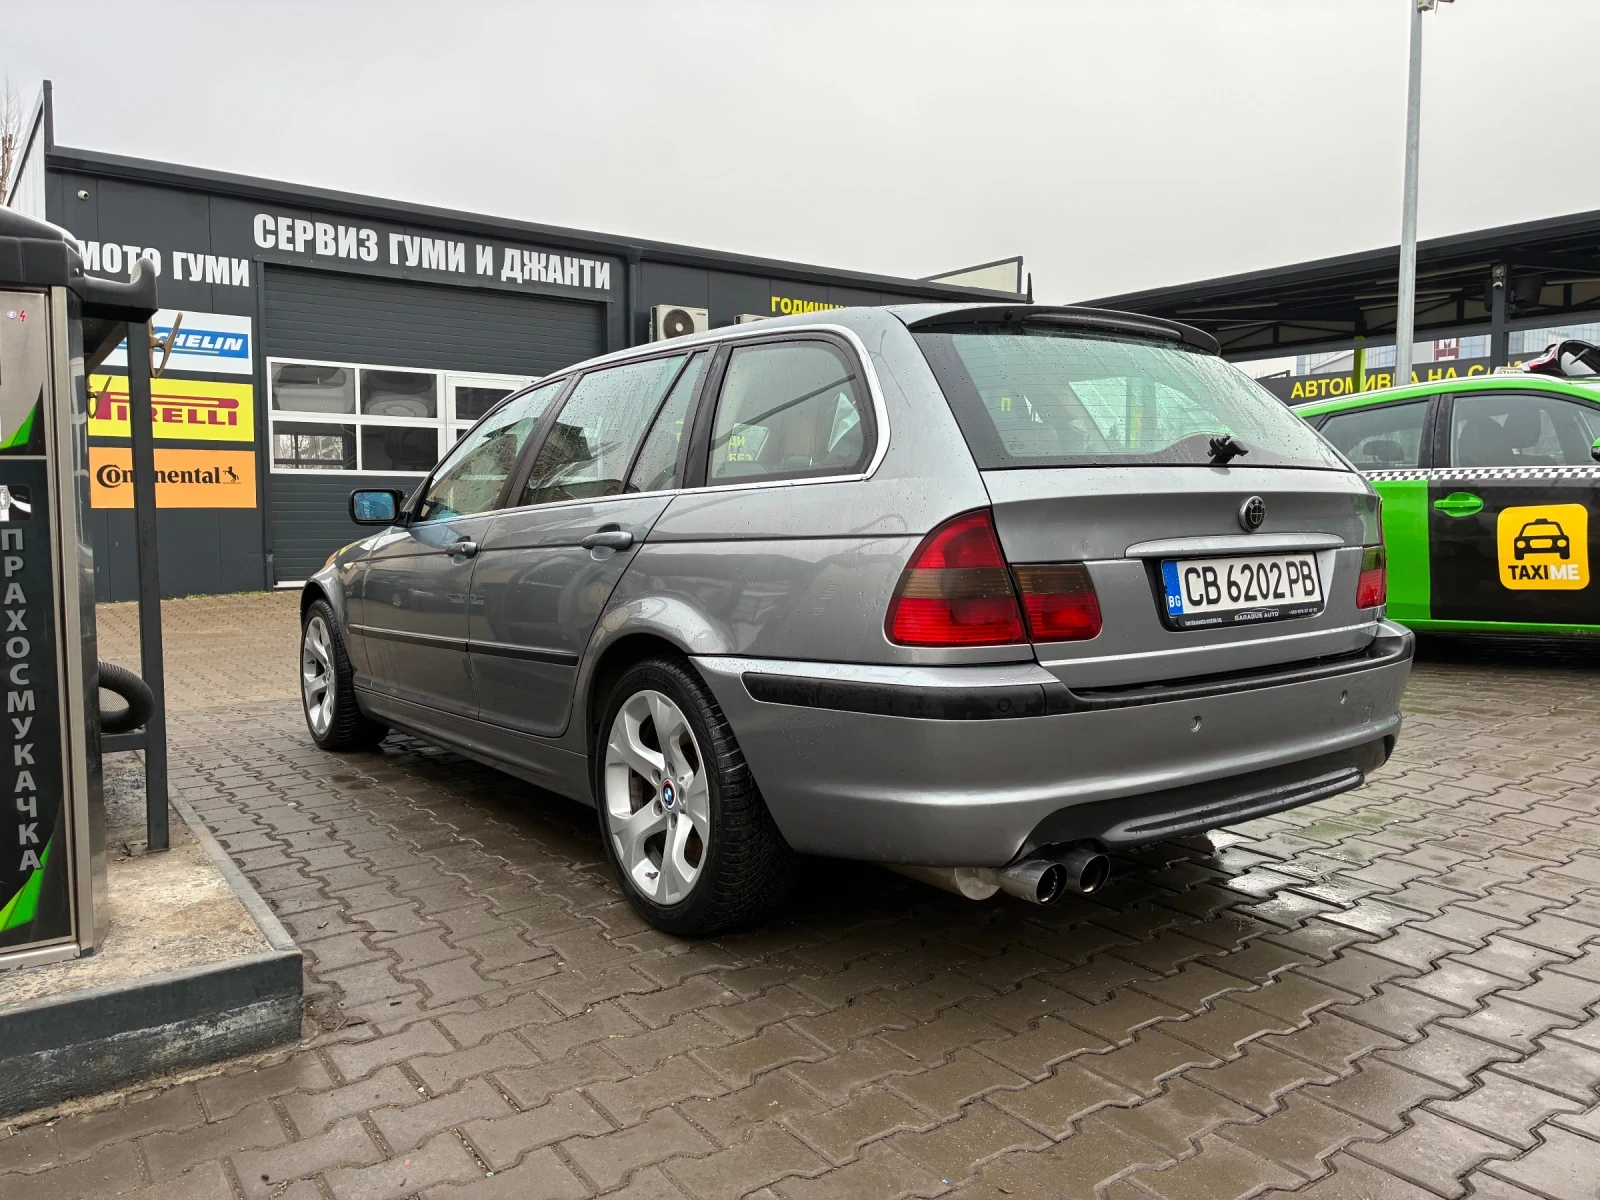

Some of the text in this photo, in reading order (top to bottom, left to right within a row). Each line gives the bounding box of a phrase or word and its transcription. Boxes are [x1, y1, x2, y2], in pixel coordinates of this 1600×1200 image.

[173, 251, 250, 287] ГУМИ
[253, 213, 610, 290] СЕРВИЗ ГУМИ И ДЖАНТИ
[96, 464, 221, 488] Connental
[1169, 595, 1181, 608] BG
[1227, 562, 1286, 603] 6202
[1, 528, 43, 871] ПРАХОСМУКАЧКА
